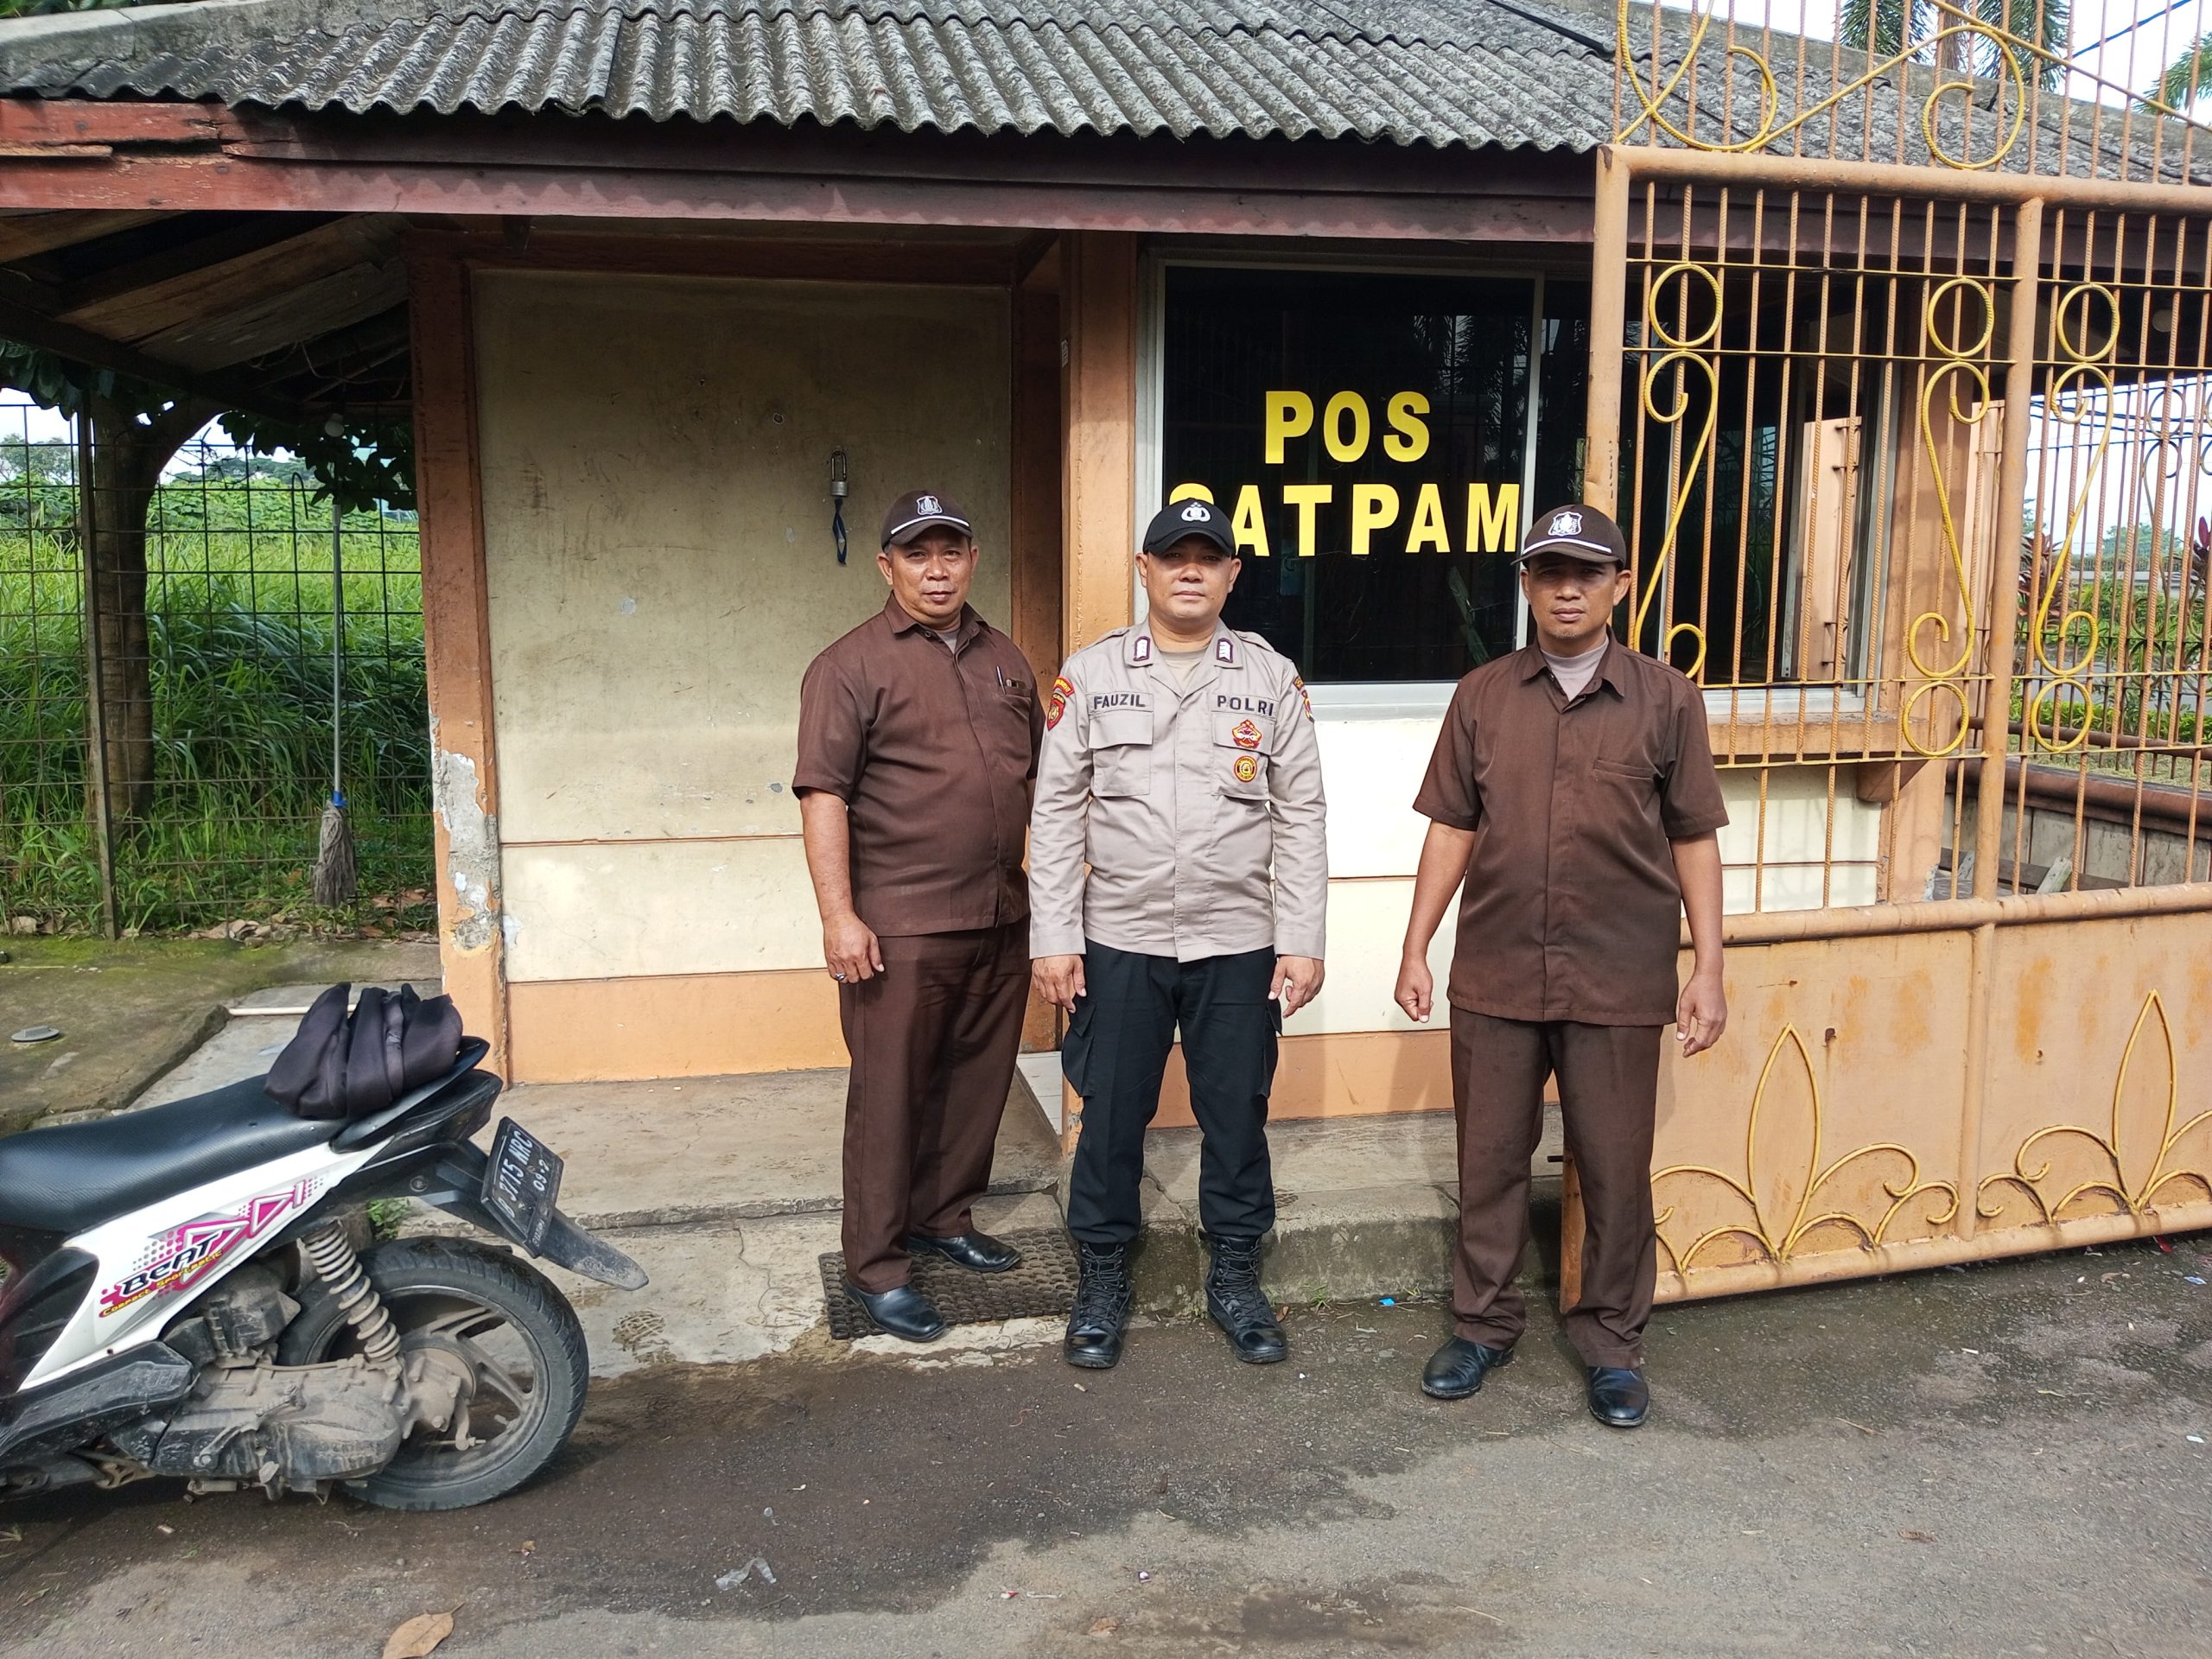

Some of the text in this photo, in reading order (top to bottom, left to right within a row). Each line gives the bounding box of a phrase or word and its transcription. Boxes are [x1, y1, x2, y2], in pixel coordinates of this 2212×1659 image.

[1265, 391, 1431, 464] POS
[1169, 483, 1520, 556] ATPAM
[1094, 694, 1147, 709] FAUZIL
[1217, 695, 1274, 716] POLRI
[499, 1159, 524, 1202] 3715
[498, 1197, 515, 1218] B
[102, 1249, 223, 1316] Compact Sportmatic
